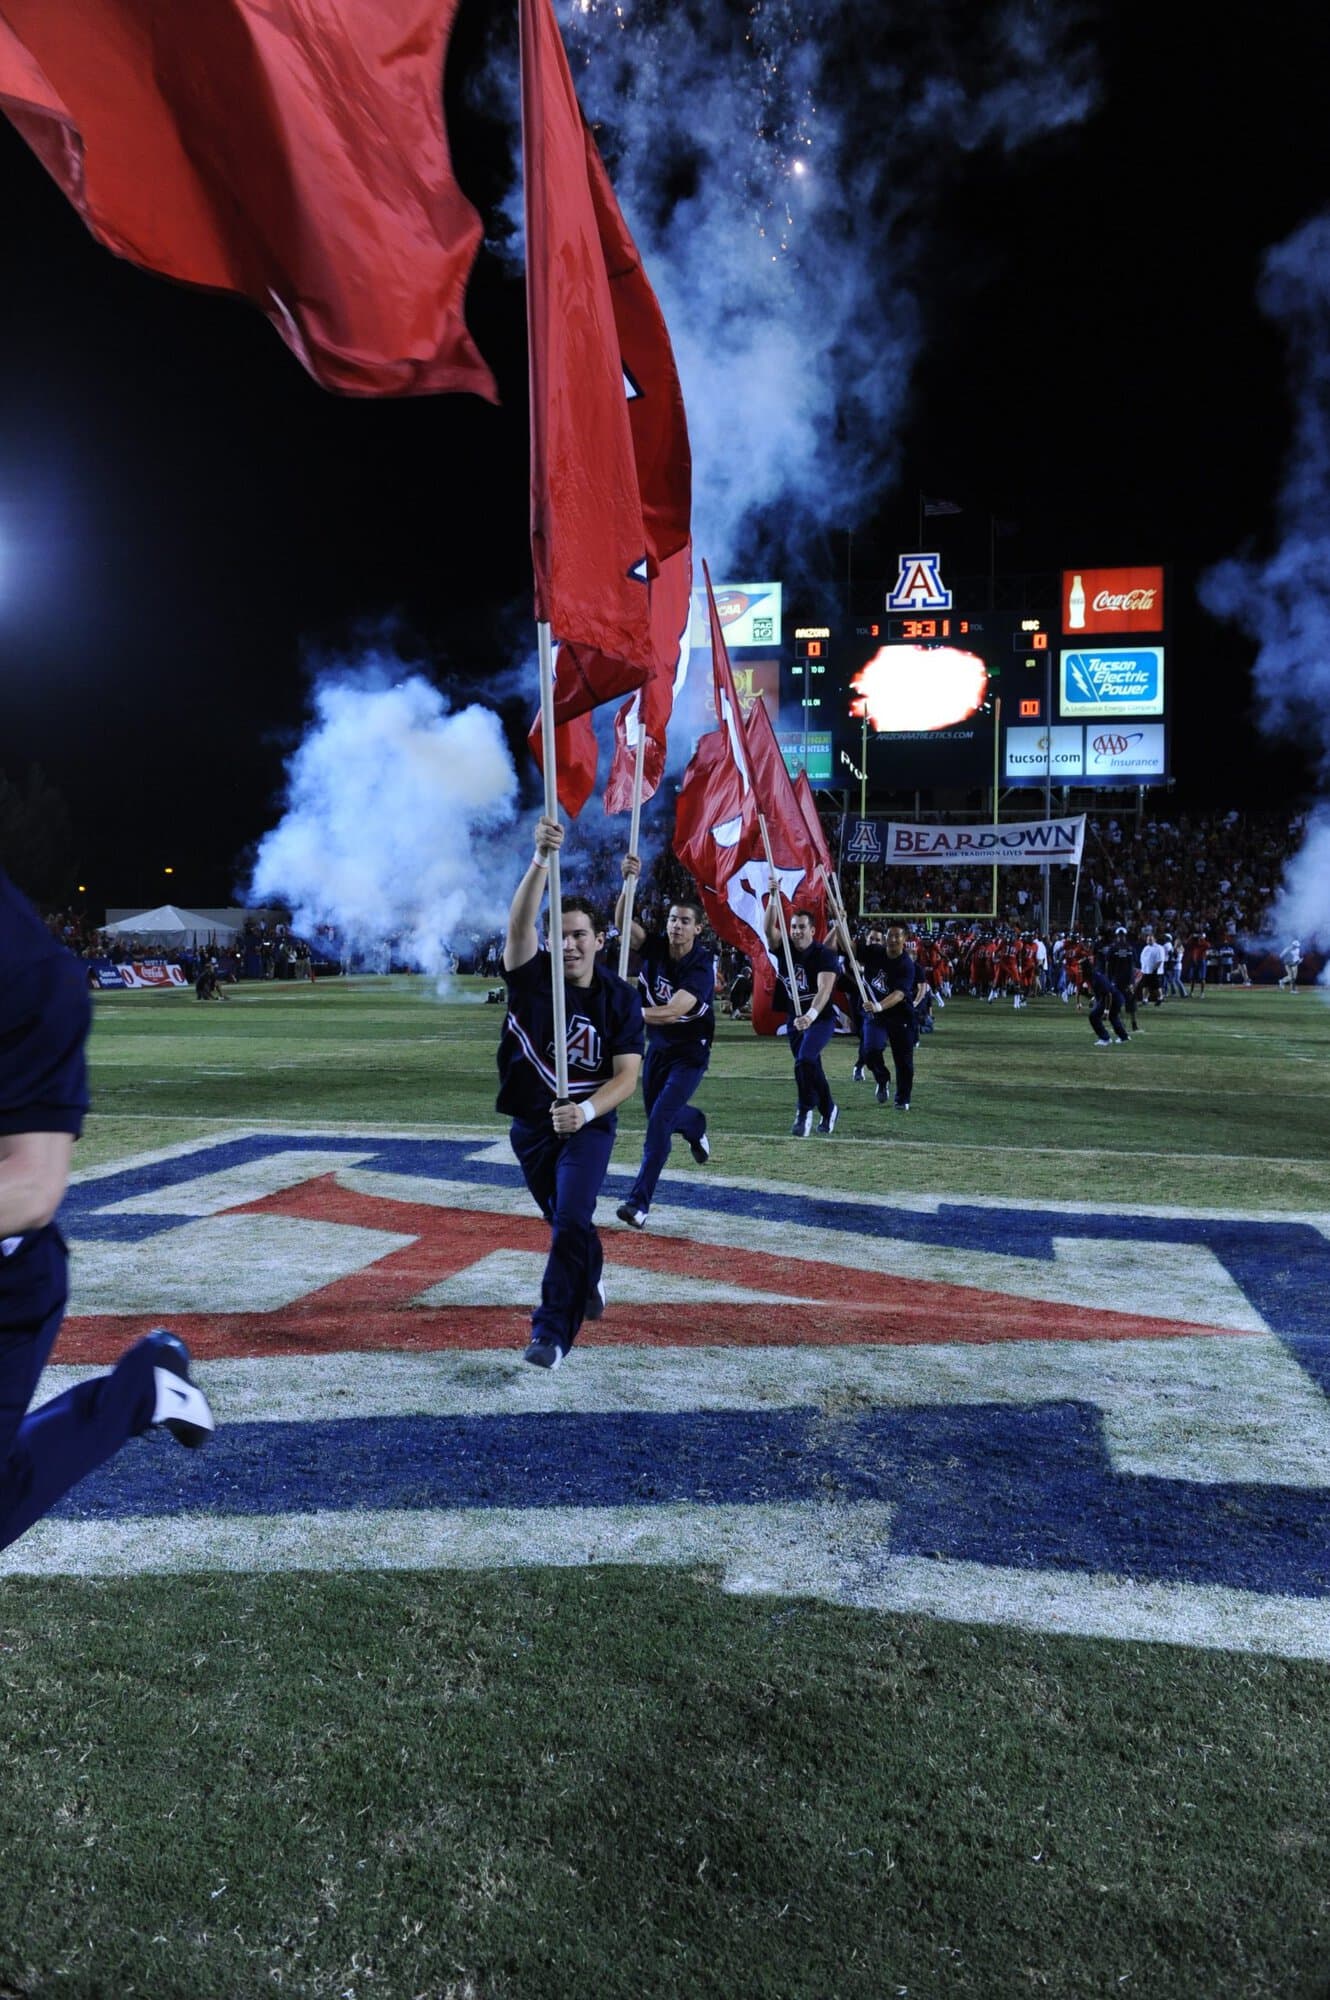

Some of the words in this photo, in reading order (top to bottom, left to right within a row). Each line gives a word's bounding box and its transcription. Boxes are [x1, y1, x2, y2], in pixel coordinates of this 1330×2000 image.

[886, 553, 952, 612] A
[754, 621, 772, 629] PAC
[871, 625, 879, 636] 3
[903, 620, 949, 637] 3:31
[960, 621, 969, 633] 3
[754, 628, 772, 638] 10
[808, 641, 821, 656] 0
[1034, 634, 1047, 649] 0
[1088, 658, 1136, 672] Tucson
[1093, 670, 1150, 683] Electric
[1099, 683, 1149, 696] Power
[1098, 734, 1125, 755] AAA
[1110, 757, 1159, 767] Insurance
[848, 821, 881, 853] A
[546, 1014, 603, 1072] A
